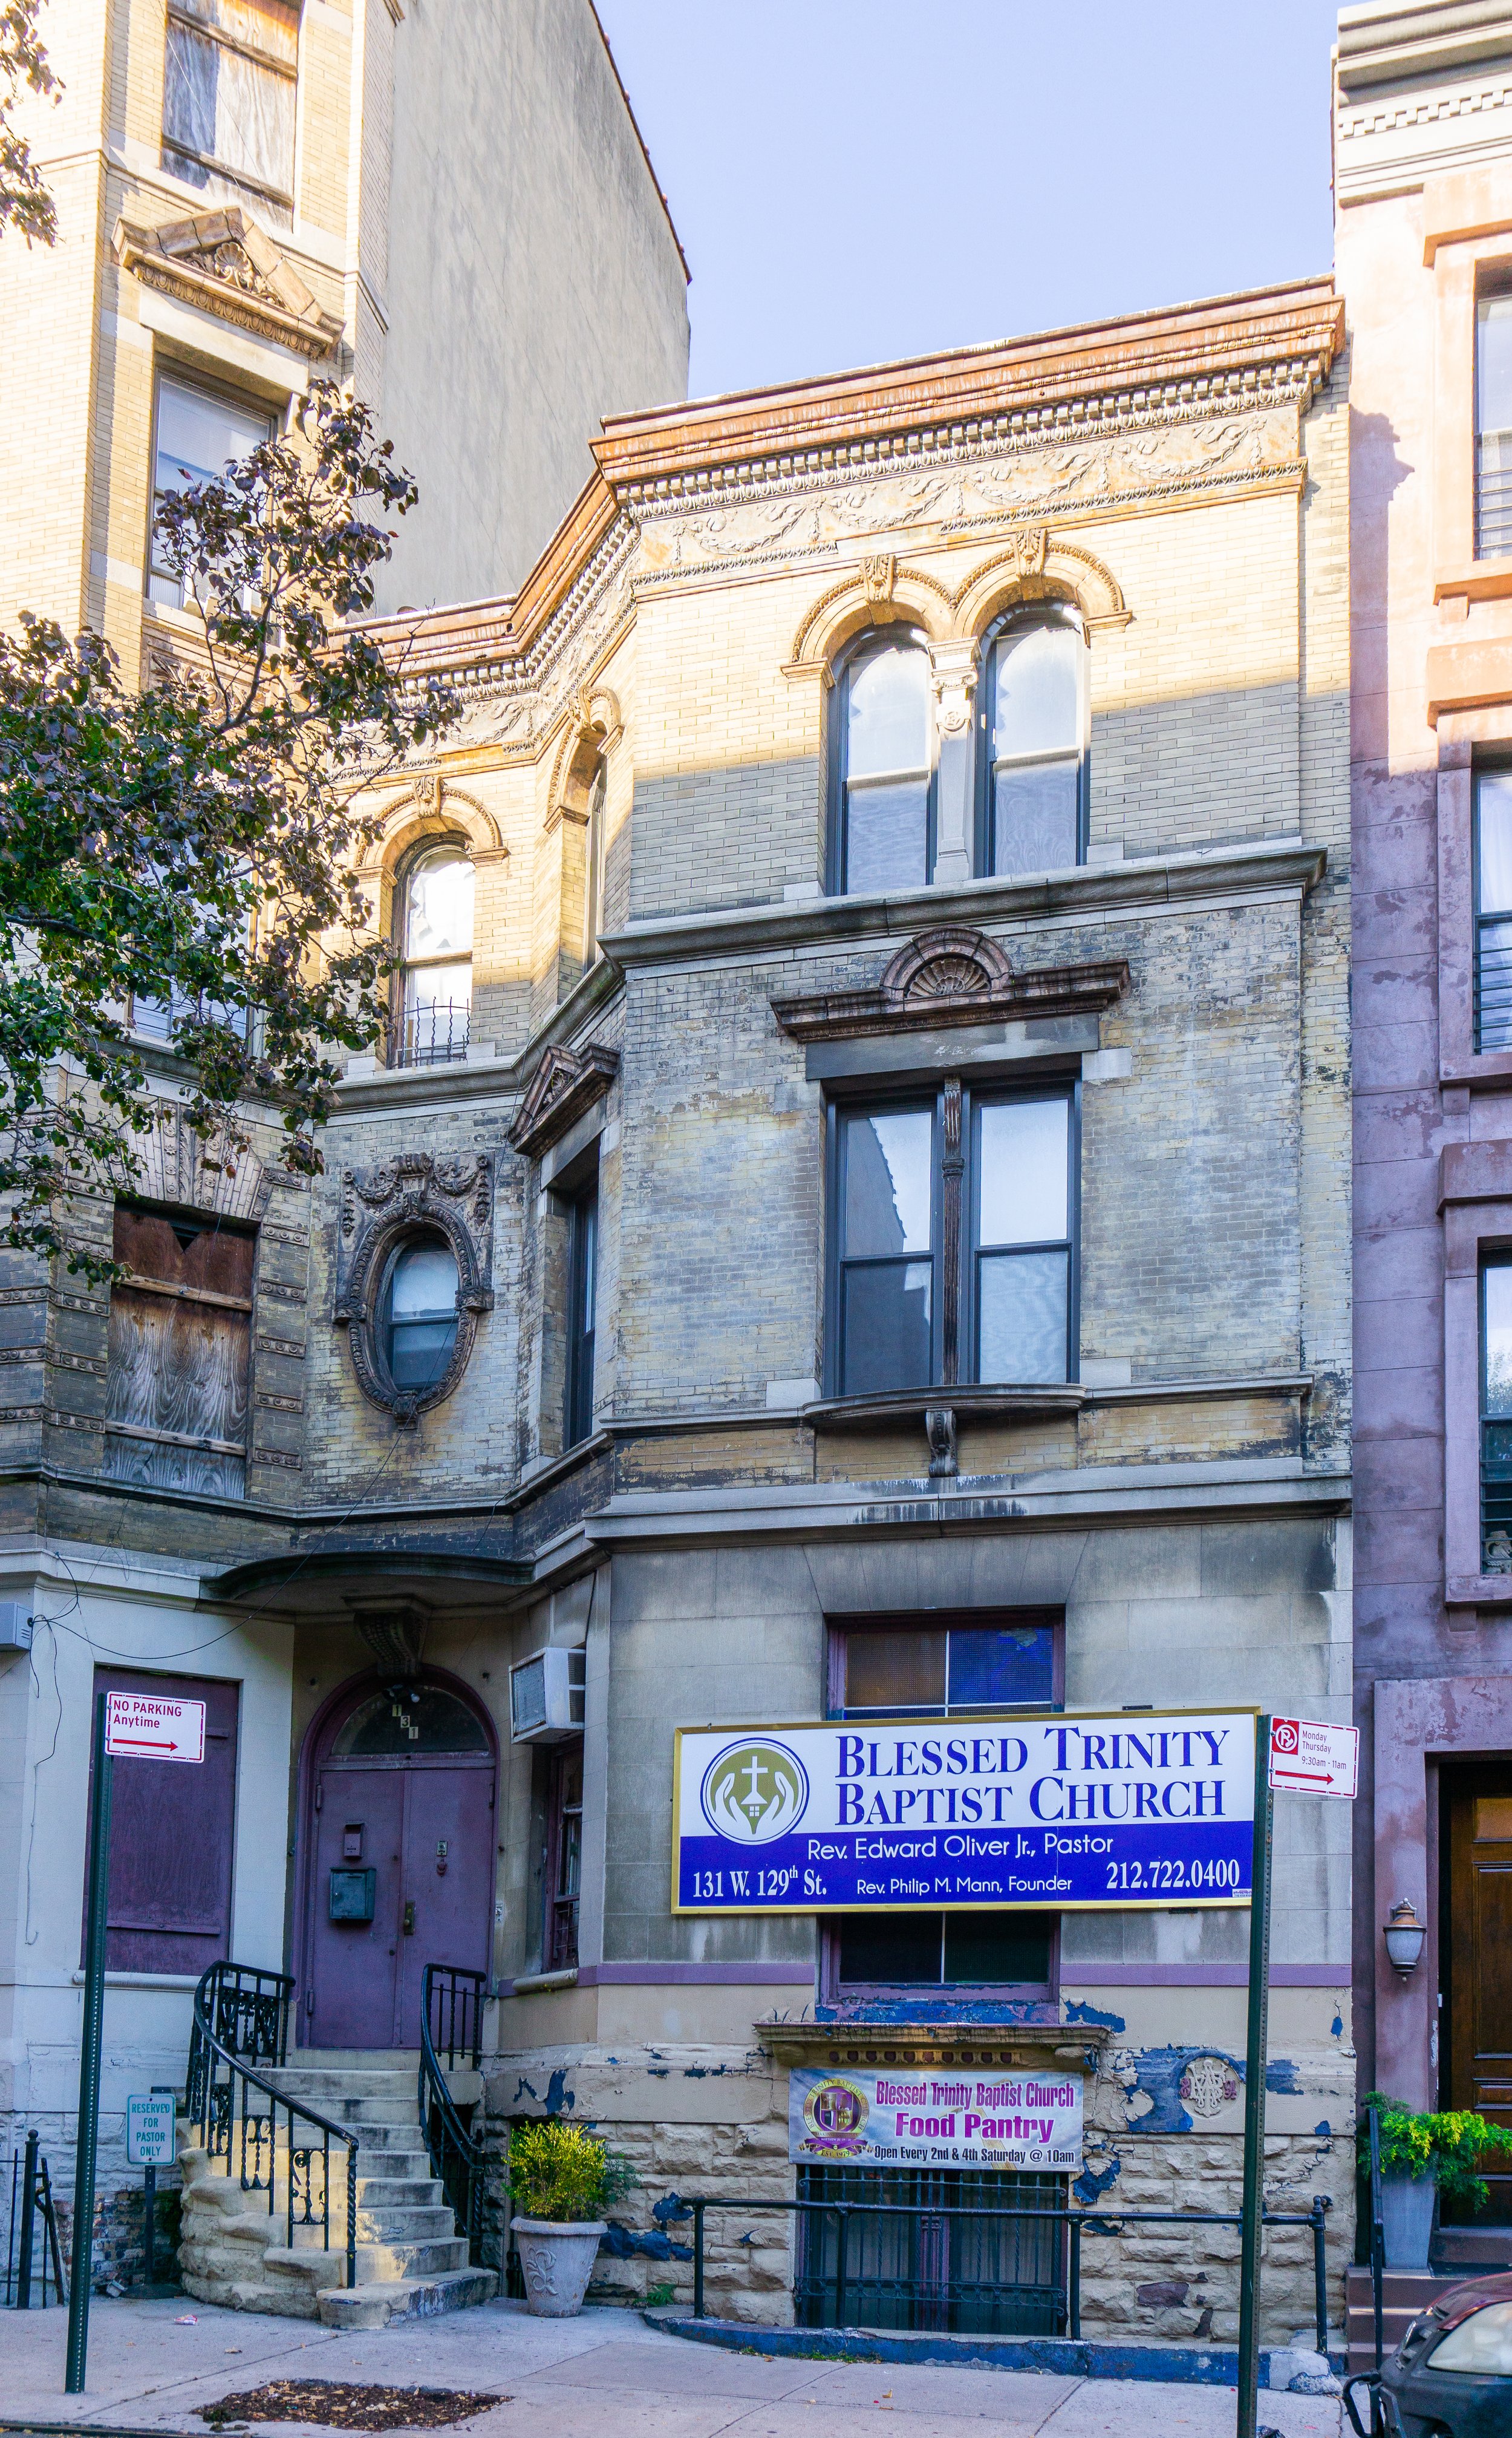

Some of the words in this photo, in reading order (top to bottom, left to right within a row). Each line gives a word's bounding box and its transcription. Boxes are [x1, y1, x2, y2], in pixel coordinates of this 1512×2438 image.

[113, 1700, 129, 1711] NO
[133, 1702, 182, 1717] PARKING
[113, 1714, 160, 1728] Anytime
[1302, 1730, 1327, 1743] Monday
[835, 1736, 1028, 1777] BLESSED
[1044, 1726, 1230, 1771] TRINITY
[1302, 1740, 1332, 1754] Thursday
[1302, 1756, 1326, 1767] 9:30am
[1332, 1760, 1347, 1770] 11am
[835, 1783, 1013, 1826] BAPTIST
[1029, 1776, 1226, 1821] CHURCH
[808, 1840, 848, 1860] Rev.
[855, 1835, 936, 1859] Edward
[944, 1834, 1009, 1857] Oliver
[1015, 1834, 1036, 1858] Jr.,
[1044, 1833, 1114, 1854] Pastor
[693, 1871, 724, 1897] 131
[729, 1871, 750, 1897] W.
[757, 1865, 798, 1896] 129th
[804, 1869, 827, 1895] St.
[1106, 1859, 1240, 1889] 212.722.0400
[857, 1879, 885, 1894] Rev.
[890, 1878, 930, 1896] Philip
[934, 1877, 951, 1893] M.
[956, 1877, 1003, 1893] Mann,
[1008, 1875, 1072, 1891] Founder
[804, 2097, 815, 2129] BLESSED
[810, 2079, 835, 2097] TRINITY
[837, 2080, 862, 2097] BAPTIST
[858, 2097, 868, 2131] CHURCH
[876, 2081, 927, 2105] Blessed
[931, 2082, 973, 2110] Trinity
[976, 2083, 1022, 2111] Baptist
[1026, 2082, 1074, 2107] Church
[131, 2103, 170, 2114] RESERVED
[143, 2117, 158, 2128] FOR
[896, 2113, 955, 2137] Food
[965, 2114, 1054, 2143] Pantry
[136, 2132, 165, 2142] PASTOR
[140, 2146, 161, 2156] ONLY
[875, 2145, 898, 2160] Open
[901, 2146, 928, 2162] Every
[931, 2147, 949, 2160] 2nd
[952, 2148, 960, 2161] &
[962, 2148, 978, 2161] 4th
[982, 2148, 1026, 2164] Saturday
[1029, 2149, 1043, 2162] @
[1047, 2149, 1074, 2163] 10am
